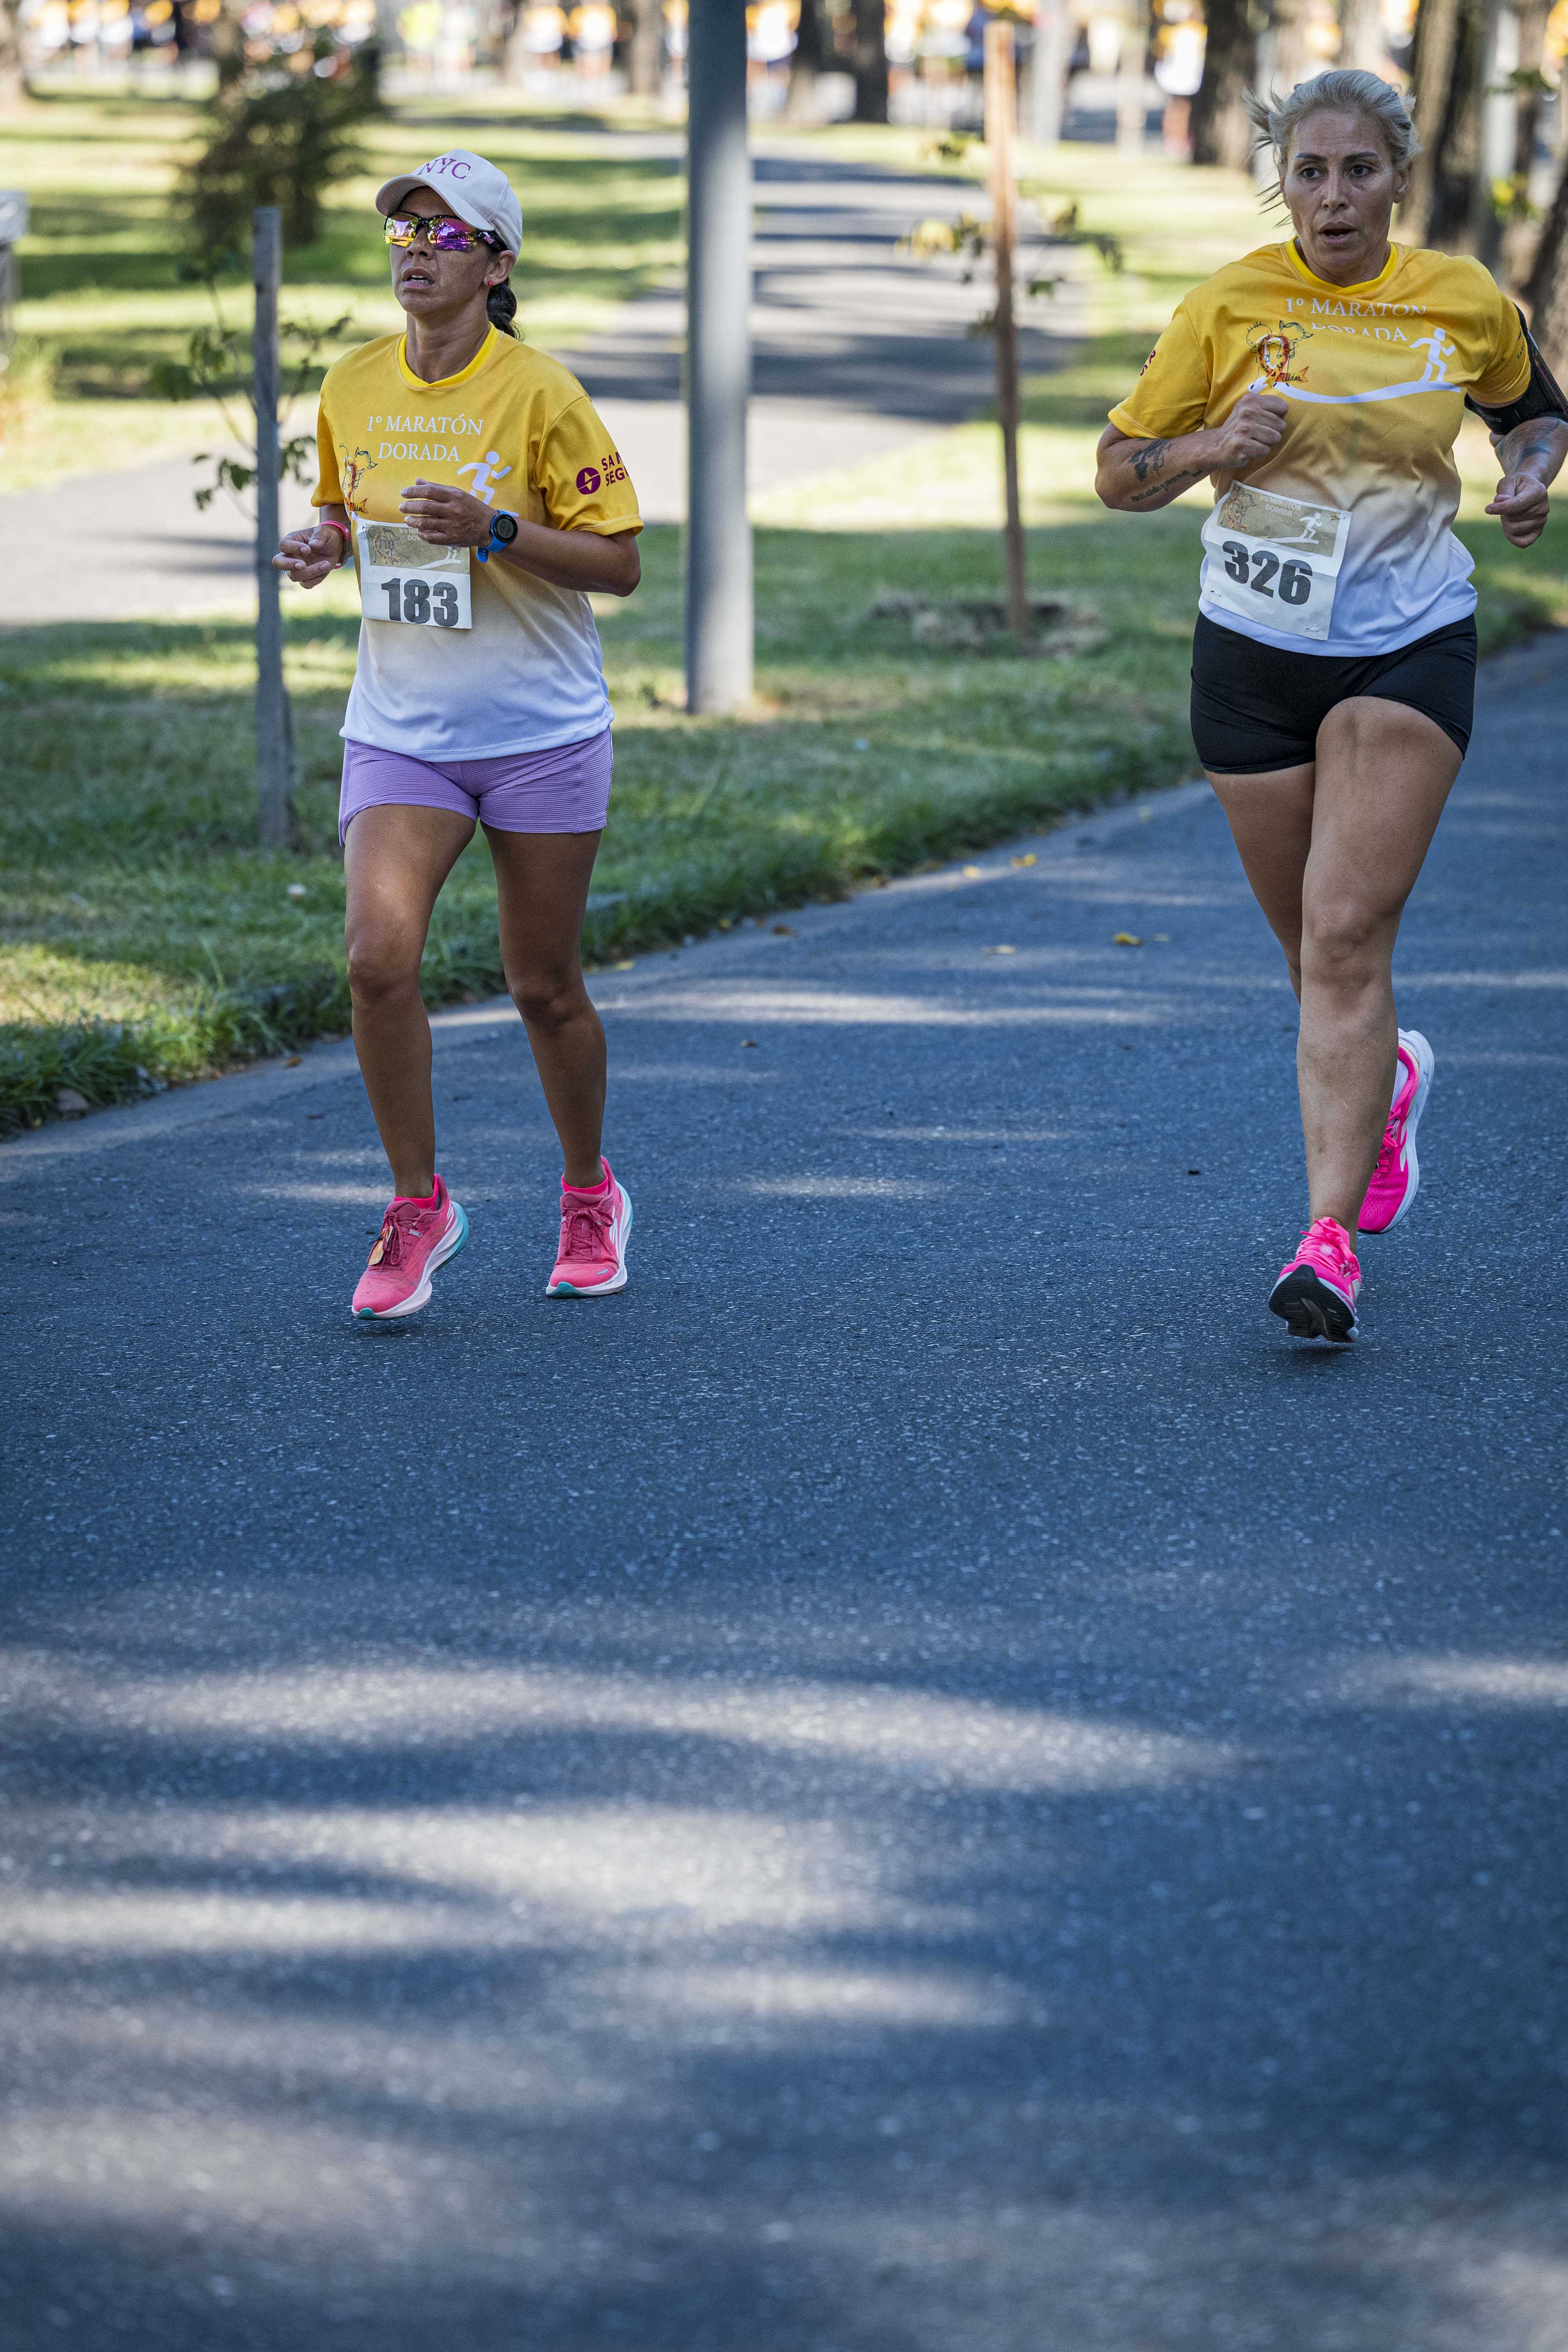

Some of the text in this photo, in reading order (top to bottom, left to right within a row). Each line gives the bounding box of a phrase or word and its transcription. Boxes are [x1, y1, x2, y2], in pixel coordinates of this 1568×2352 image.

[417, 158, 471, 179] NYC
[385, 413, 485, 435] MARATÓN
[377, 442, 460, 461] DORADA
[605, 466, 630, 487] SEG
[1265, 504, 1292, 517] DORADA
[1222, 540, 1313, 605] 326
[381, 578, 459, 627] 183
